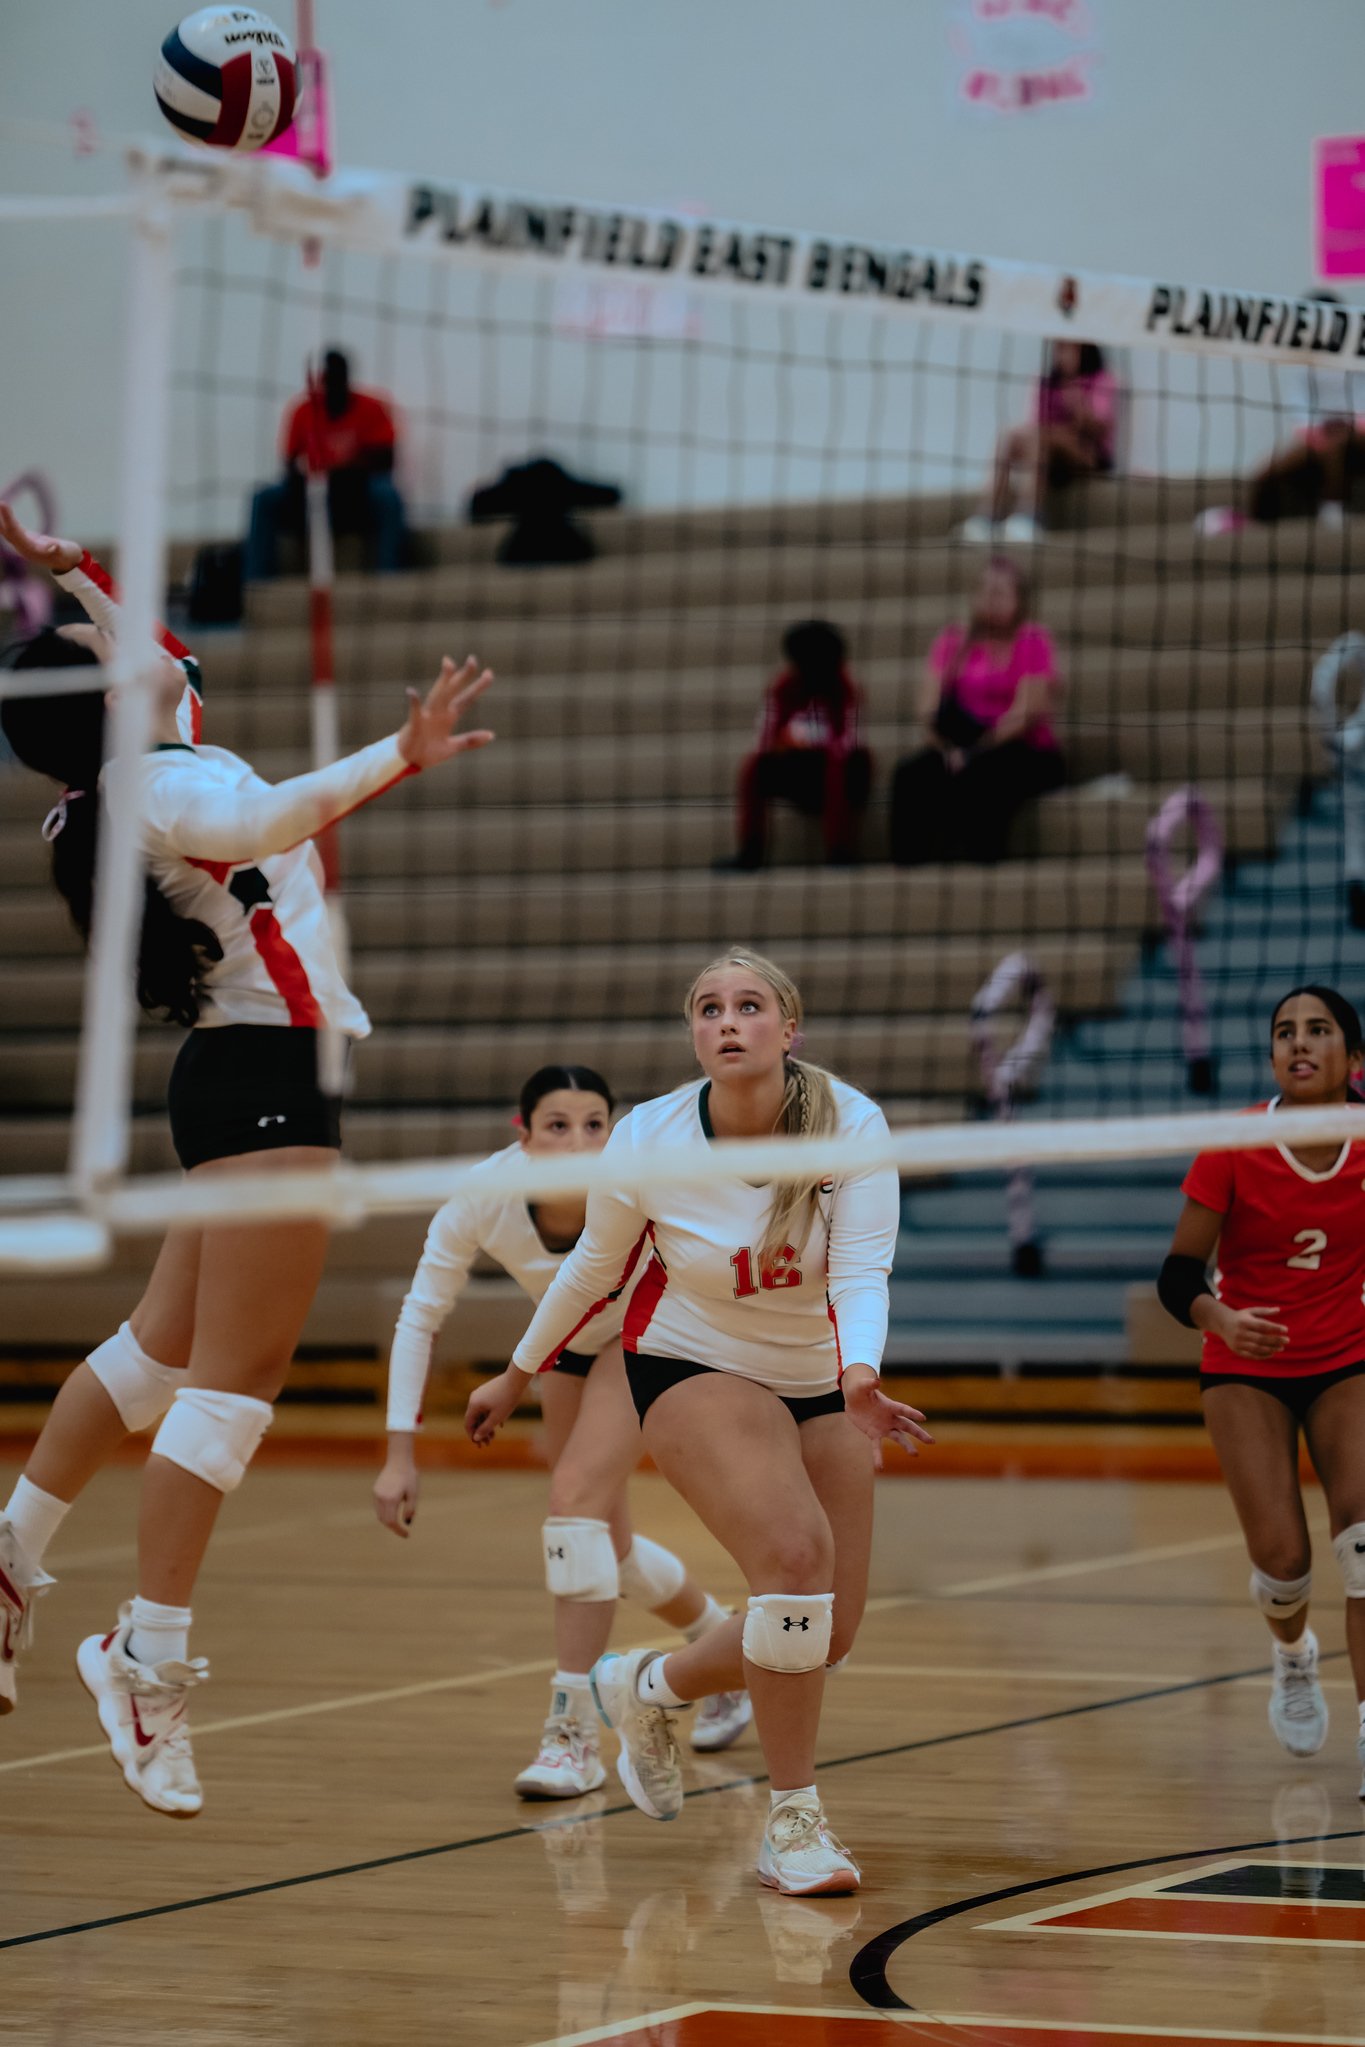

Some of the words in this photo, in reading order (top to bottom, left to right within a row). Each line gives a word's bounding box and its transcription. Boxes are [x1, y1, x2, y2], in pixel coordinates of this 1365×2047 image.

[404, 183, 683, 272] PLAINFIELD
[691, 222, 796, 287] EAST
[804, 238, 986, 309] BENGALS
[1145, 285, 1349, 353] PLAINFIELD
[730, 1243, 802, 1299] 16
[1286, 1228, 1328, 1271] 2
